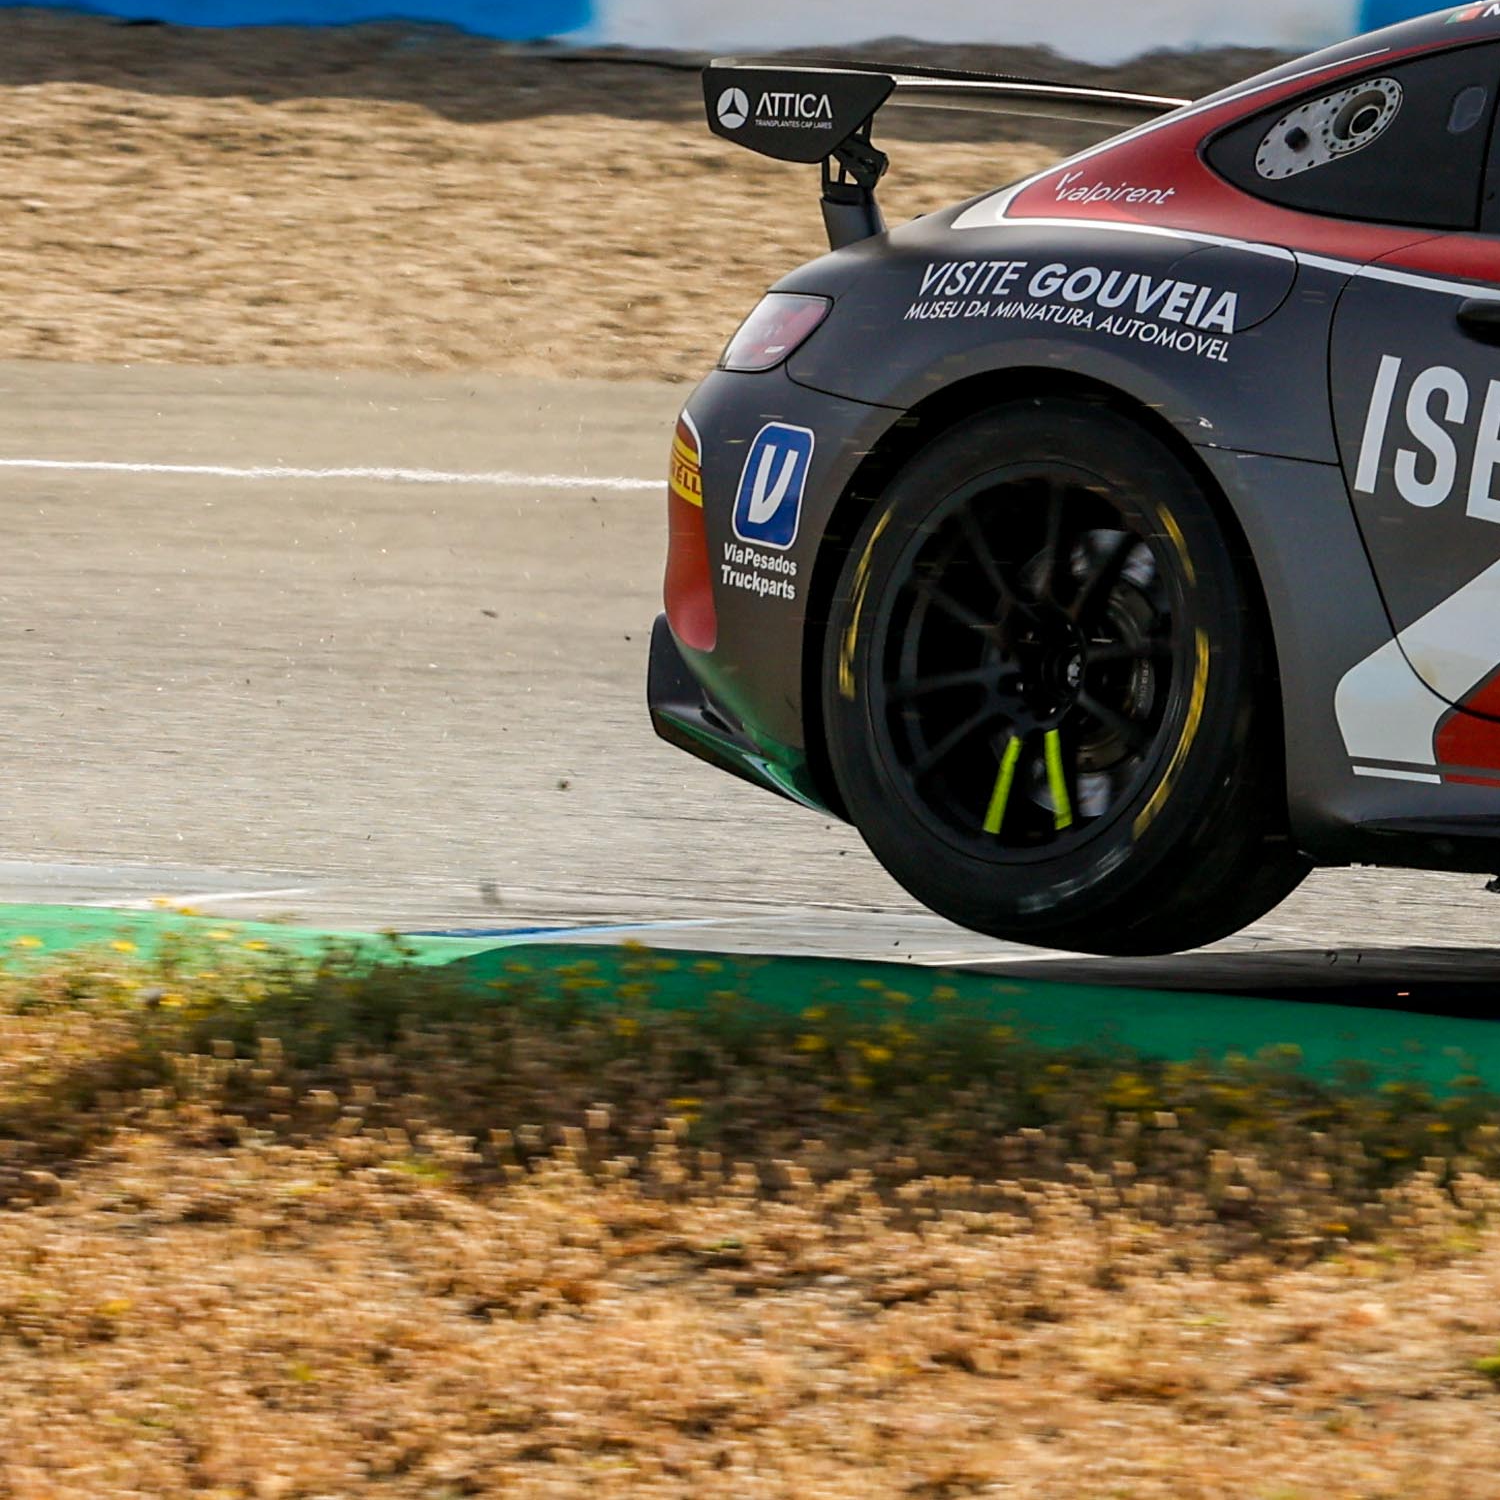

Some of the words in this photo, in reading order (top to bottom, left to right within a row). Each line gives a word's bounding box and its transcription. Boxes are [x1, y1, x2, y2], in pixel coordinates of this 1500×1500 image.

[755, 92, 832, 118] ATTICA
[801, 121, 832, 129] CAPLARES
[919, 261, 1027, 296] VISITE
[1028, 263, 1238, 334] GOUVEIA
[904, 302, 964, 320] MUSEU
[964, 300, 989, 318] DA
[993, 301, 1095, 329] MINIATURA
[1096, 314, 1229, 362] AUTOMOVEL
[724, 542, 797, 576] ViaPesados
[721, 564, 796, 599] Truckparts
